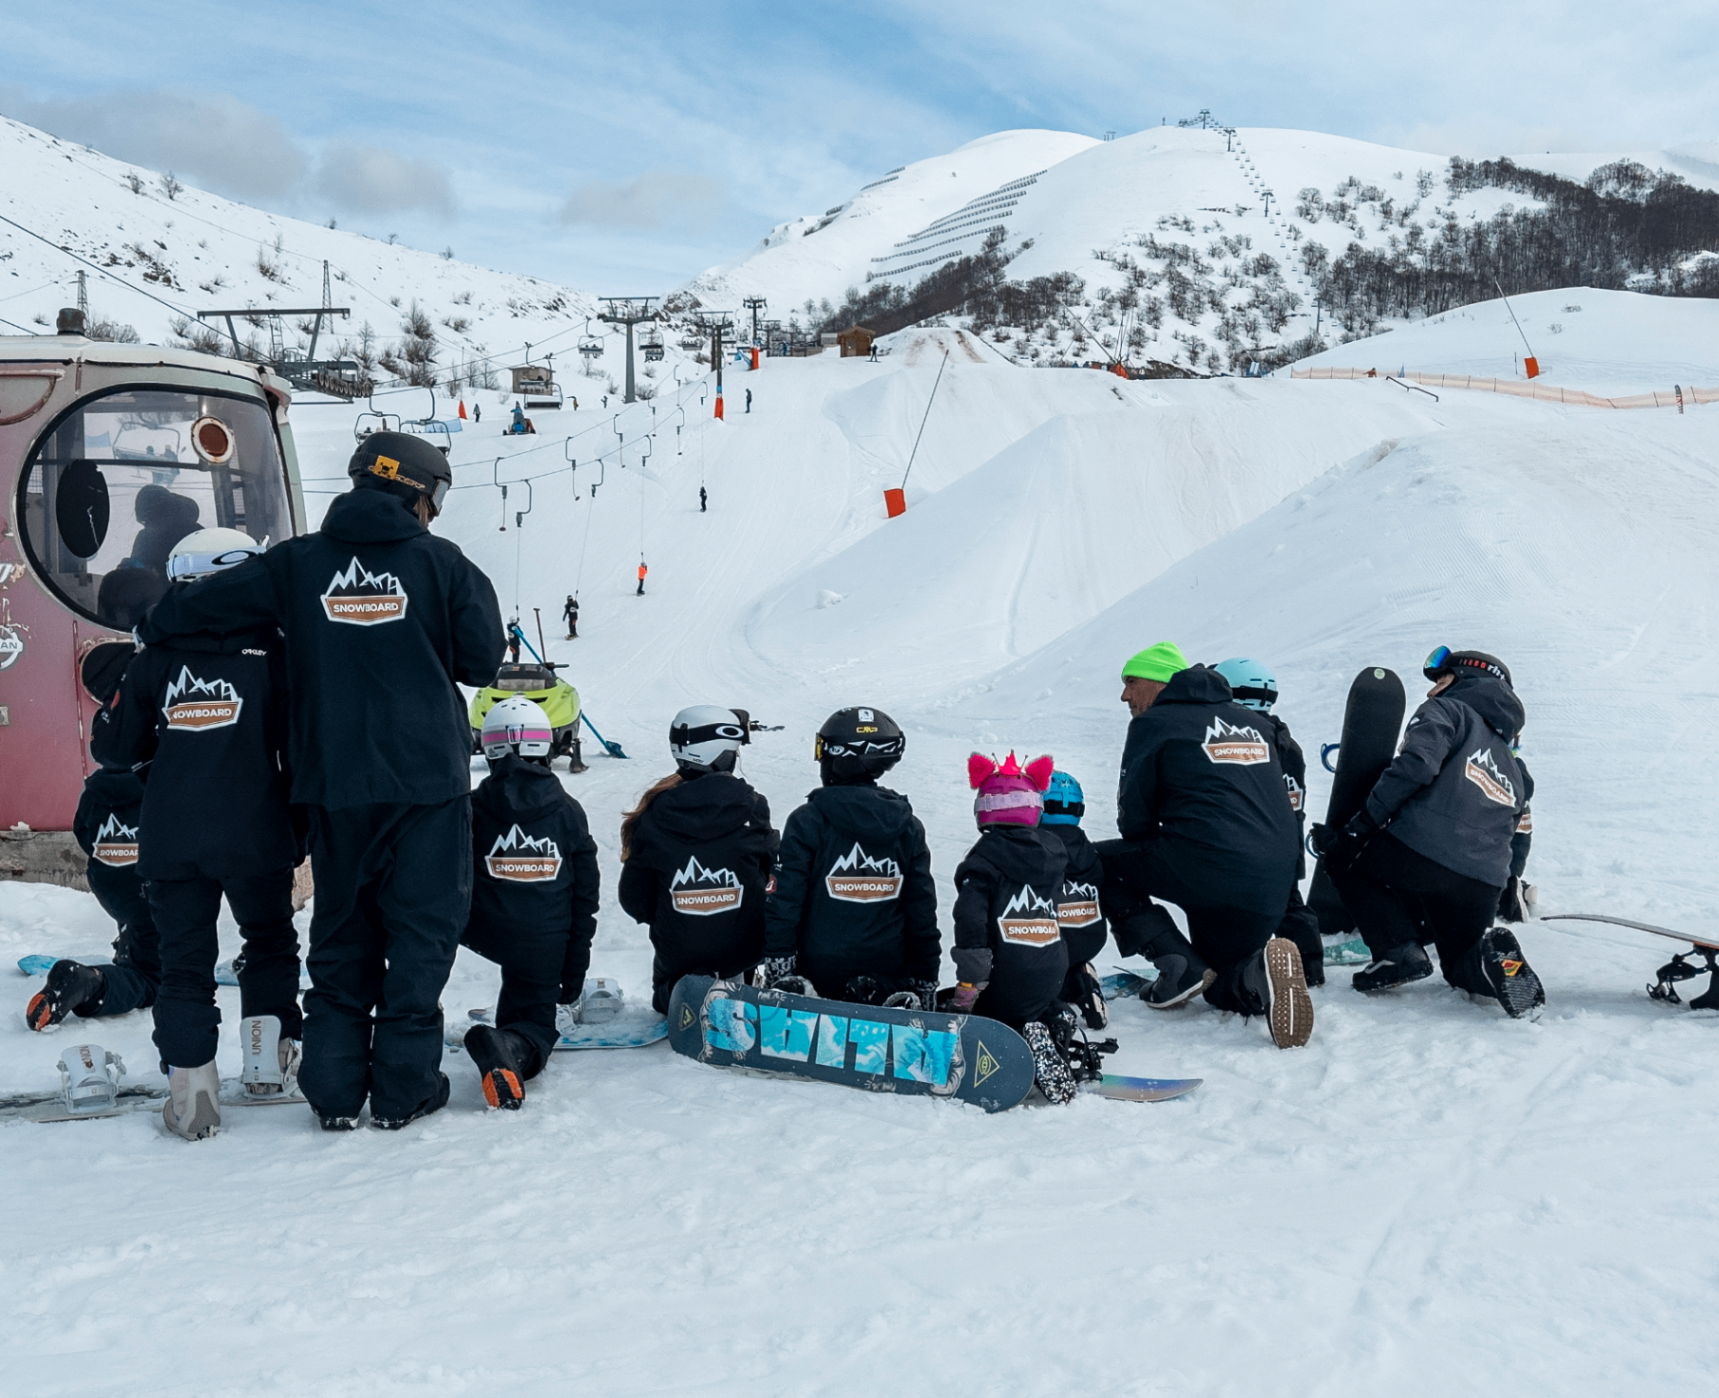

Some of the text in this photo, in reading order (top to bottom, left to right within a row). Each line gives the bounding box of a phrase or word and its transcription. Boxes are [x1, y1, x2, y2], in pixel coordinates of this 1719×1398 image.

[333, 603, 399, 613] SNOWBOARD
[171, 708, 232, 719] NOWBOARD
[1214, 747, 1265, 757] SNOWBOARD
[495, 863, 555, 873] SNOWBOARD
[834, 883, 895, 892] SNOWBOARD
[676, 893, 736, 905] SNOWBOARD
[251, 1019, 262, 1056] UNION
[706, 999, 958, 1086] ALIAS
